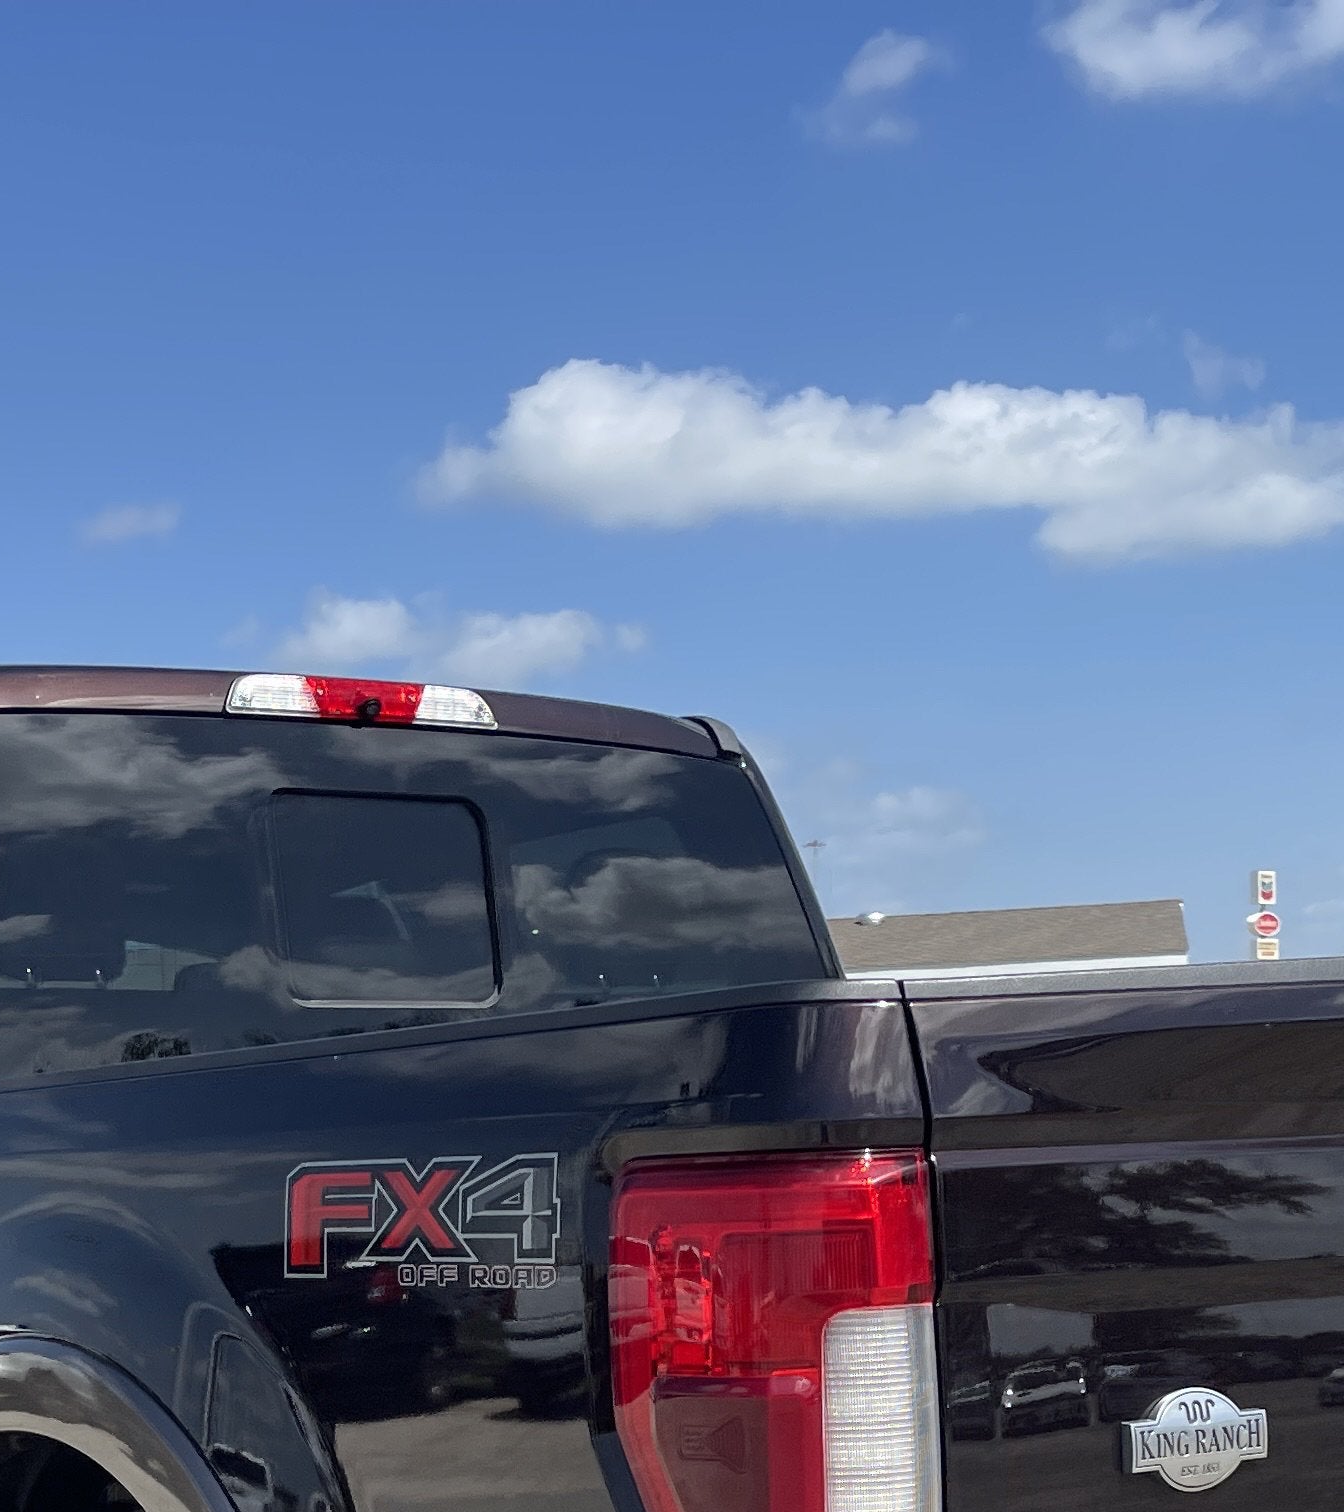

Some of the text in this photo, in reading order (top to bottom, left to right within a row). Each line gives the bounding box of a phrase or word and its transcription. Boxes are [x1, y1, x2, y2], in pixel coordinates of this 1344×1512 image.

[284, 1152, 561, 1279] FX4
[397, 1263, 558, 1290] OFF ROAD
[1140, 1418, 1262, 1461] KING RANCH
